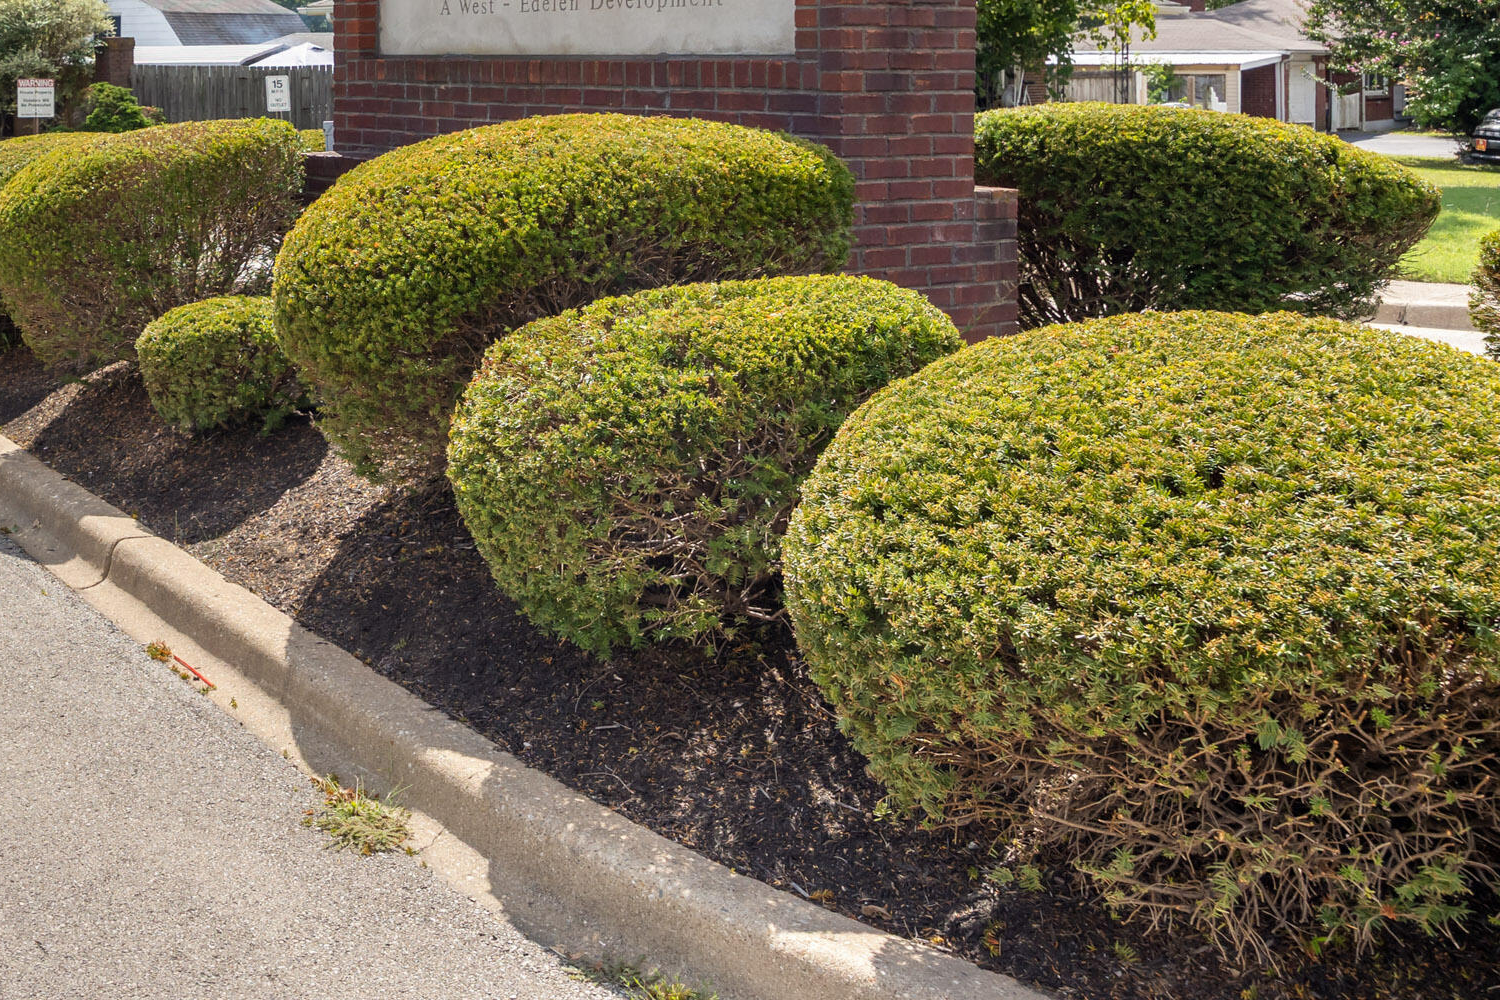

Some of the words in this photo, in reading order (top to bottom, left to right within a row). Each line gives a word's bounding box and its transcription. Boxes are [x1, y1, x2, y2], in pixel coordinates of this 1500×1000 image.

[440, 0, 451, 16] A
[19, 79, 54, 87] WARNING
[272, 79, 283, 89] 15
